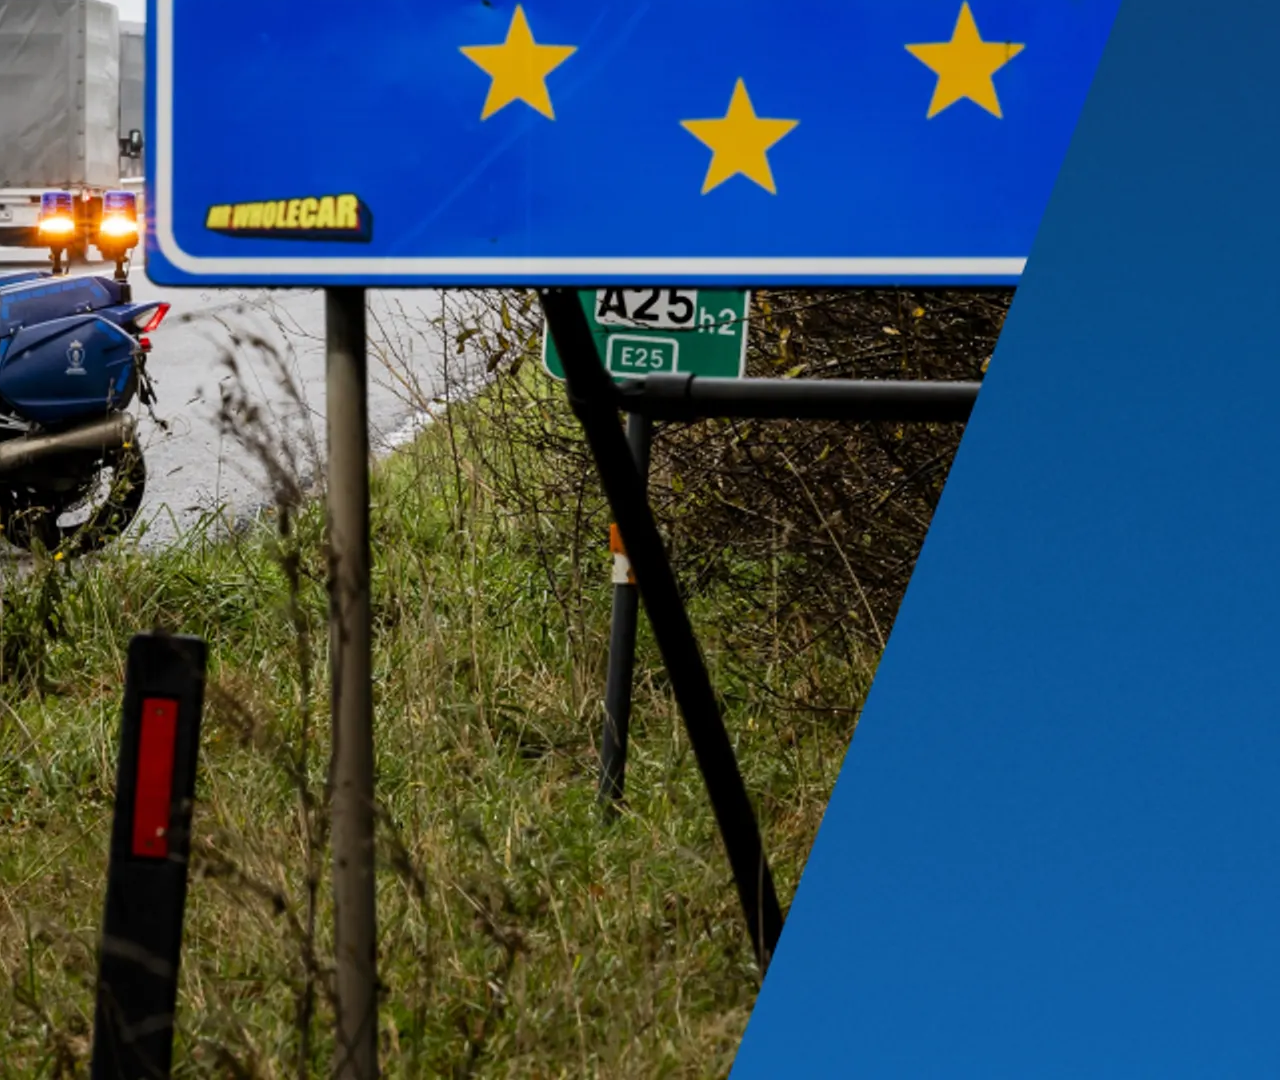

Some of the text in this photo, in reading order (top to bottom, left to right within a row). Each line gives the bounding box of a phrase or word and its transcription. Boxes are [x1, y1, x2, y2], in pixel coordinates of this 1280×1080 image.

[232, 193, 360, 230] WHOLECAR
[597, 288, 694, 325] A25
[620, 346, 664, 369] E25
